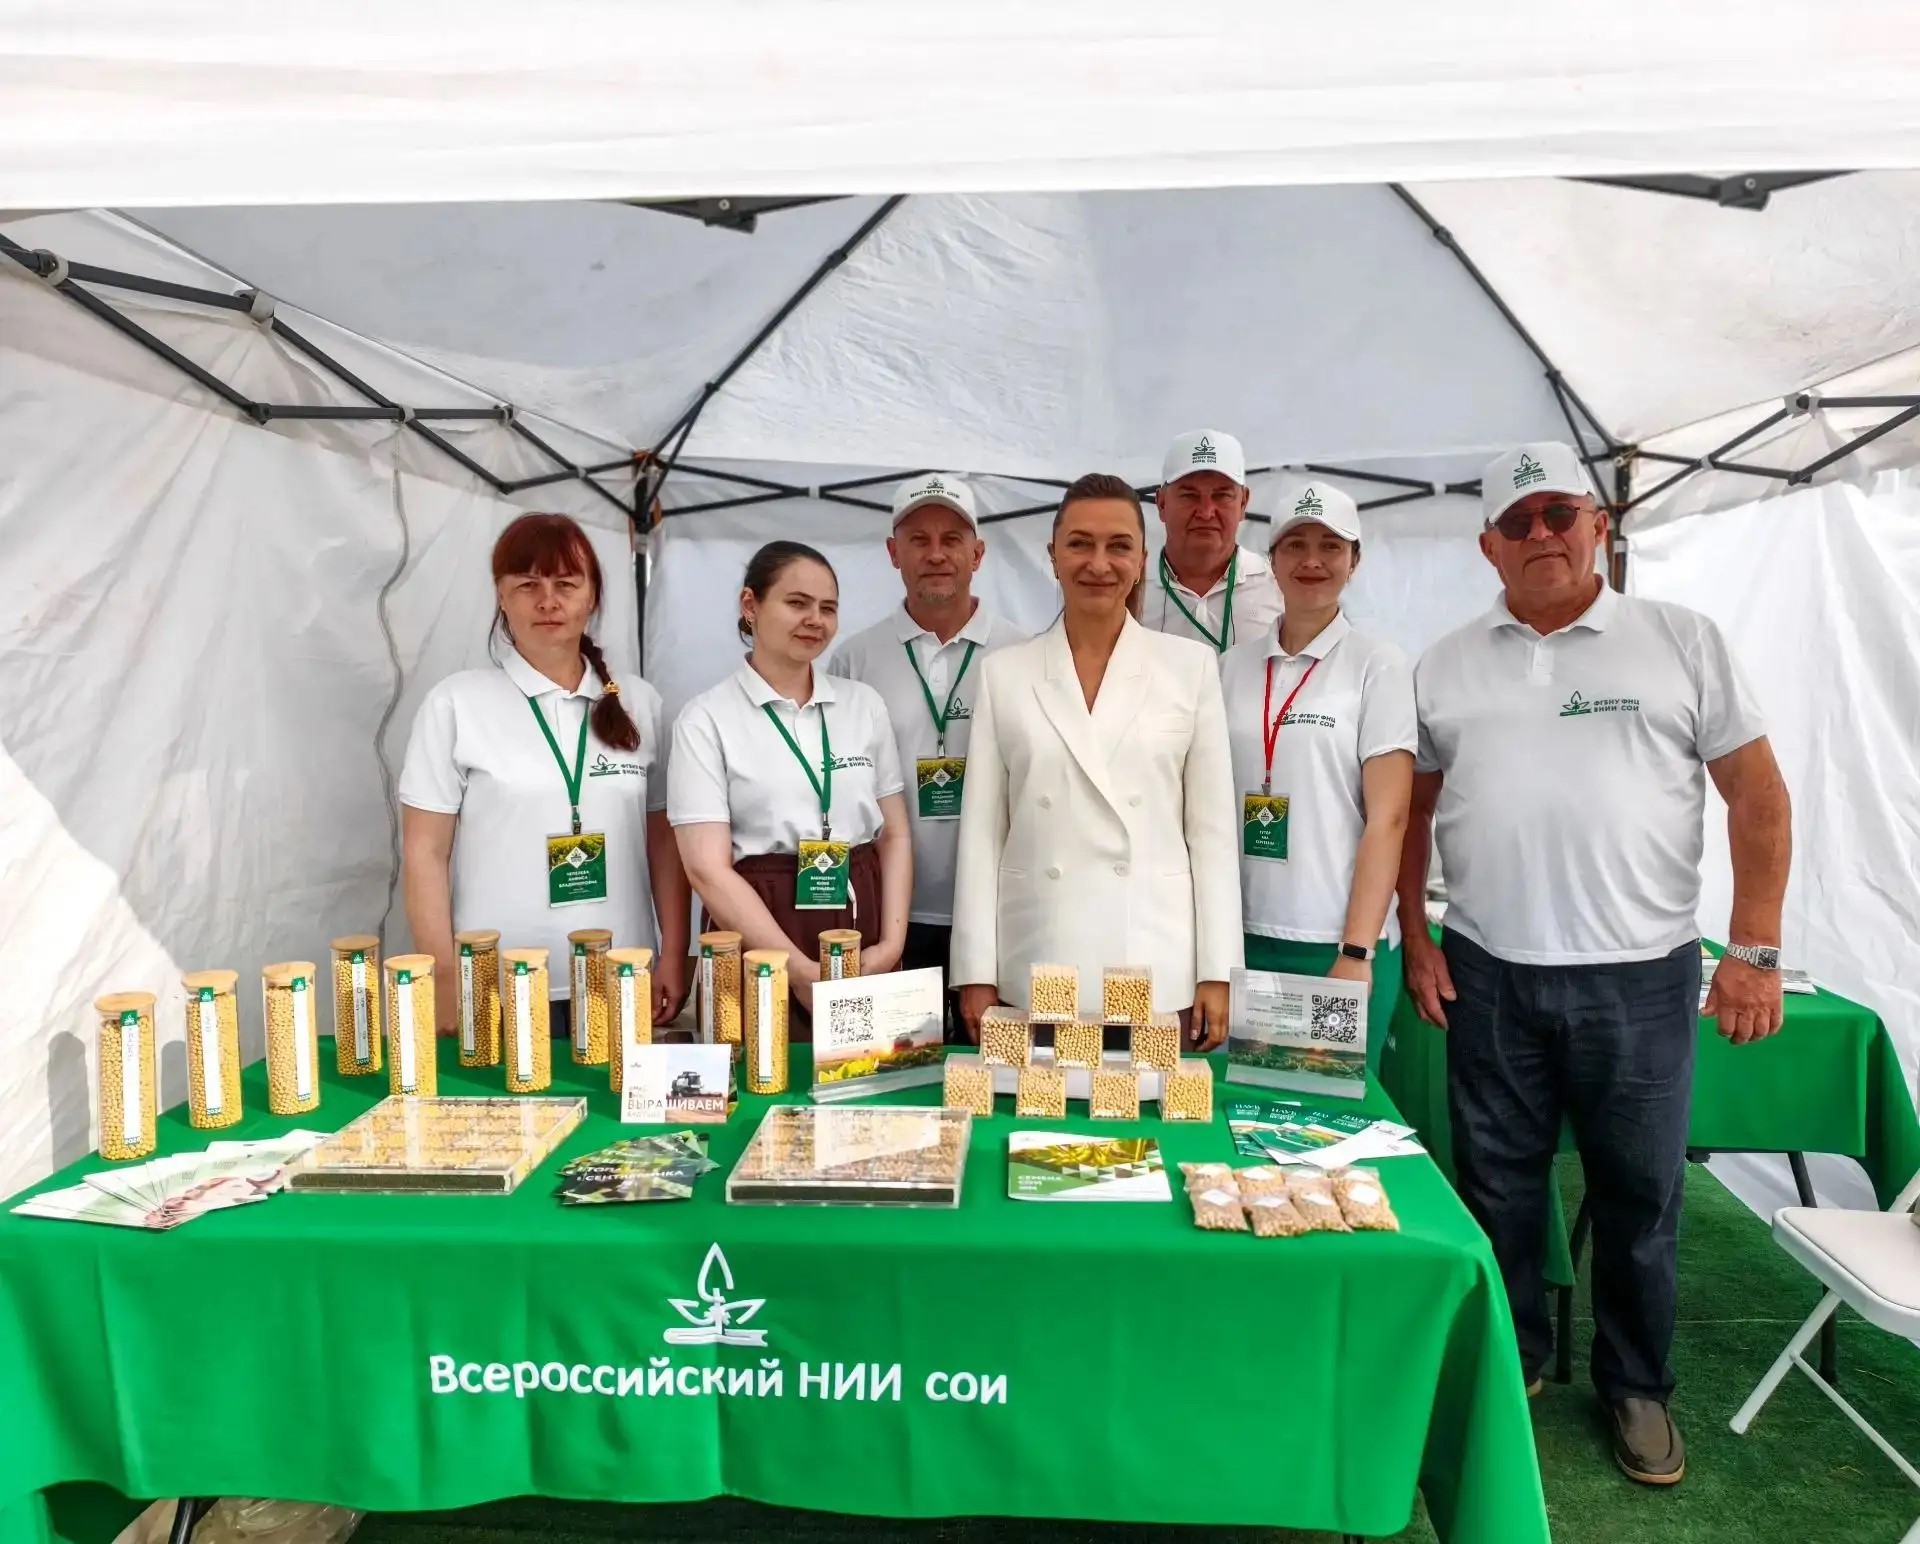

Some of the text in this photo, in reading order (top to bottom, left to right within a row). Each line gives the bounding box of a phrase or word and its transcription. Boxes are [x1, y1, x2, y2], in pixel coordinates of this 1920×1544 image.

[910, 490, 944, 498] ИНСТИТУТ
[1319, 720, 1335, 728] СОИ
[1321, 715, 1336, 724] ФНЦ
[627, 1098, 724, 1112] ВЫРАЩИВАЕМ
[430, 1355, 1007, 1405] Всероссийский НИИ сои
